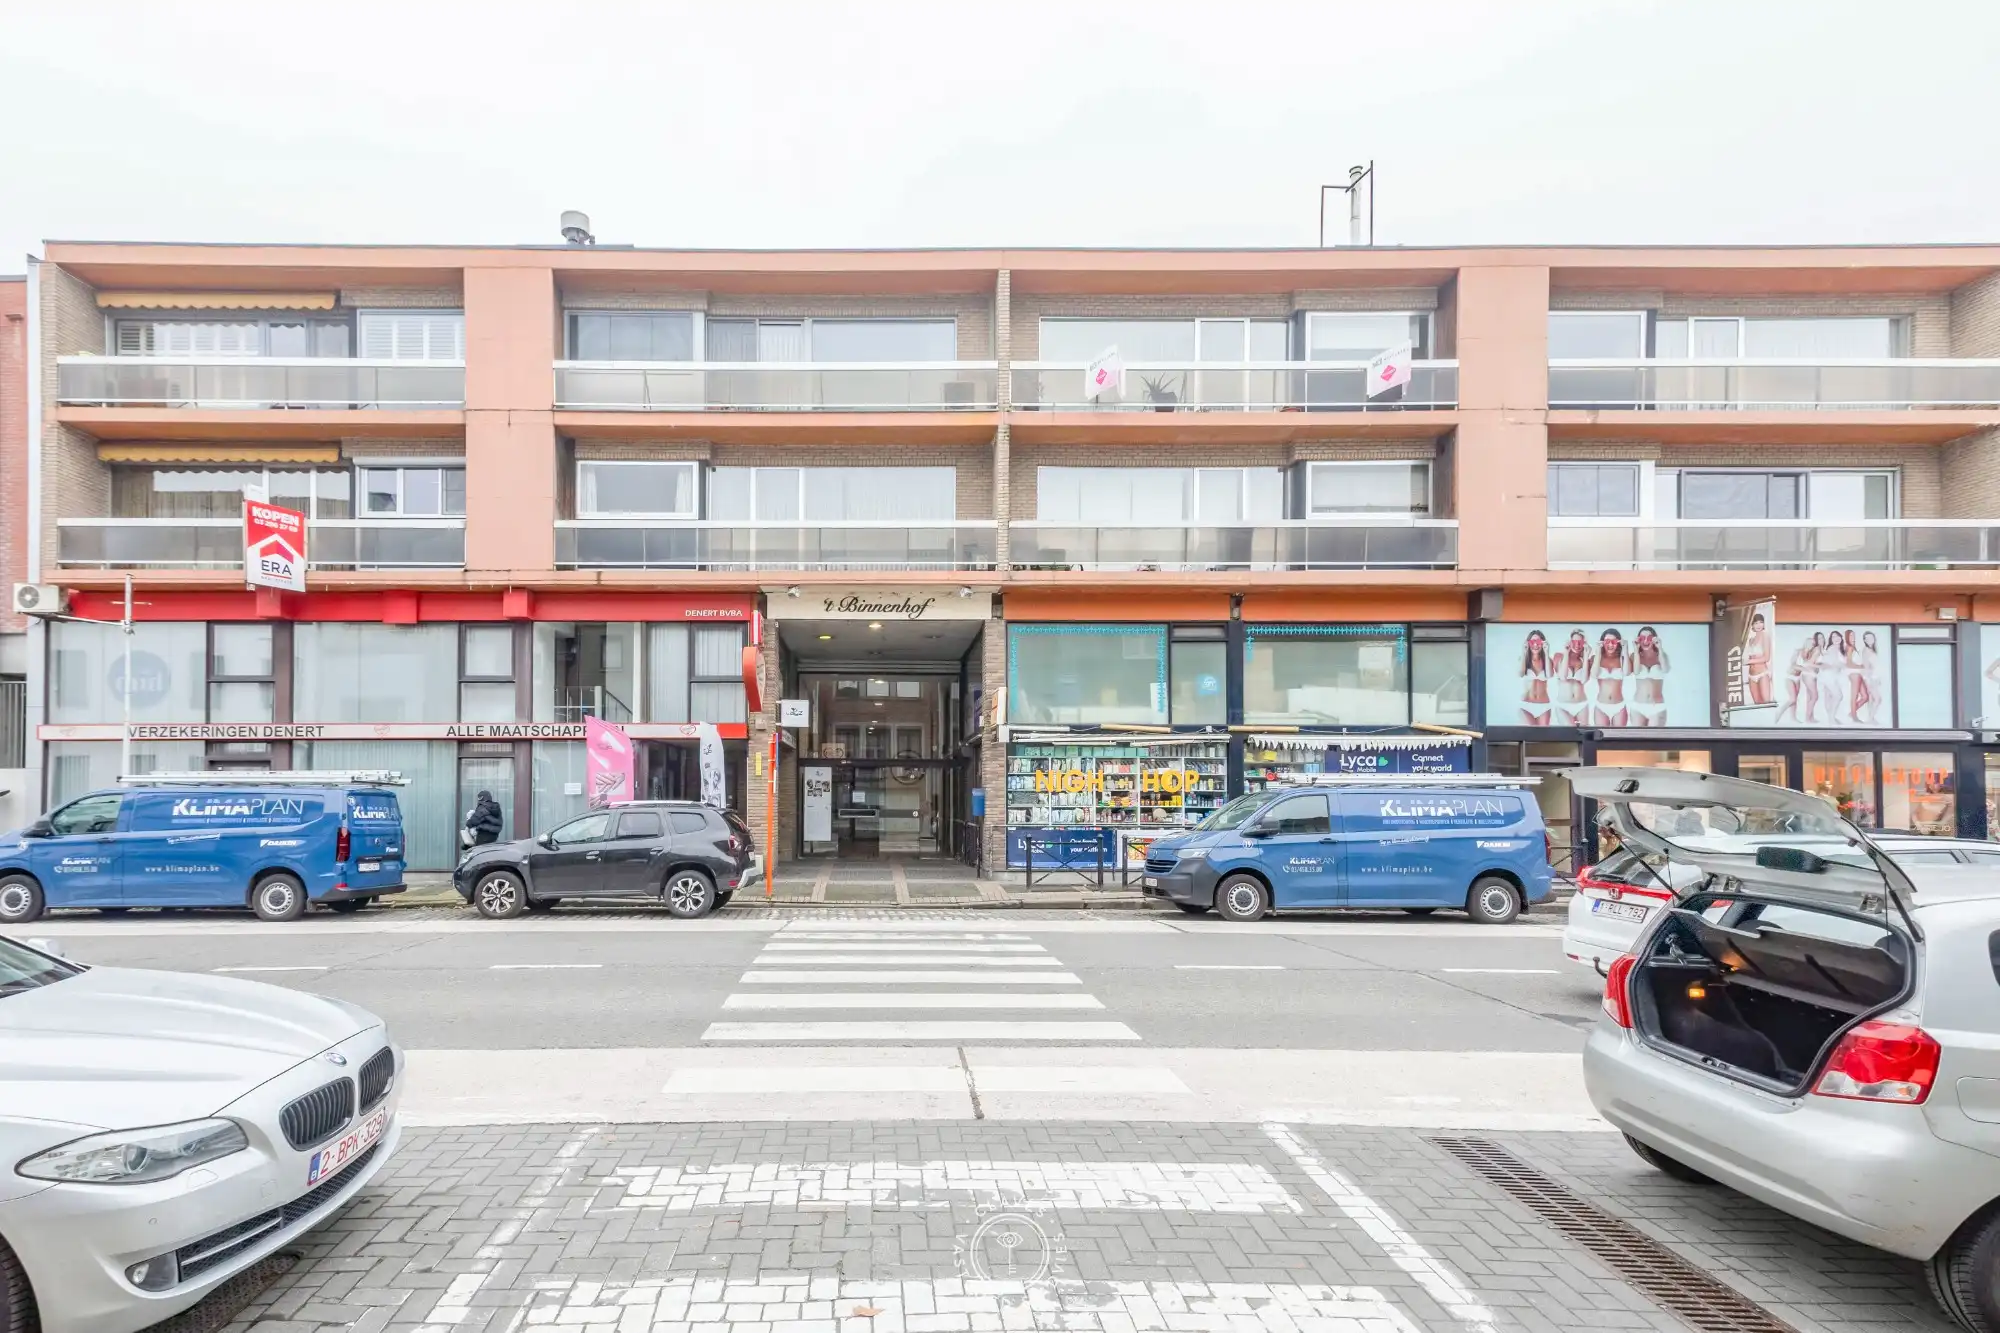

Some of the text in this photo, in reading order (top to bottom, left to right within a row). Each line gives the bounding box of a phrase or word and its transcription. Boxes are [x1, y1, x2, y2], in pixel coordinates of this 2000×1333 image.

[252, 506, 299, 526] KOPEN
[261, 560, 292, 576] ERA
[685, 609, 743, 617] DENERT BVBA
[838, 596, 935, 620] Binnenhof
[129, 725, 325, 738] VERZEKERINGEN DENERT
[446, 725, 486, 737] ALLE
[1341, 753, 1377, 770] Lyca
[1412, 754, 1444, 762] Connect
[1431, 764, 1452, 772] world
[172, 798, 304, 816] KLIMAPLAN
[353, 806, 400, 819] KLIMAPLAN
[1380, 799, 1504, 817] KLIMAPLAN
[145, 865, 220, 873] www.klimaplan.be
[1362, 866, 1433, 875] www.klimaplan.be
